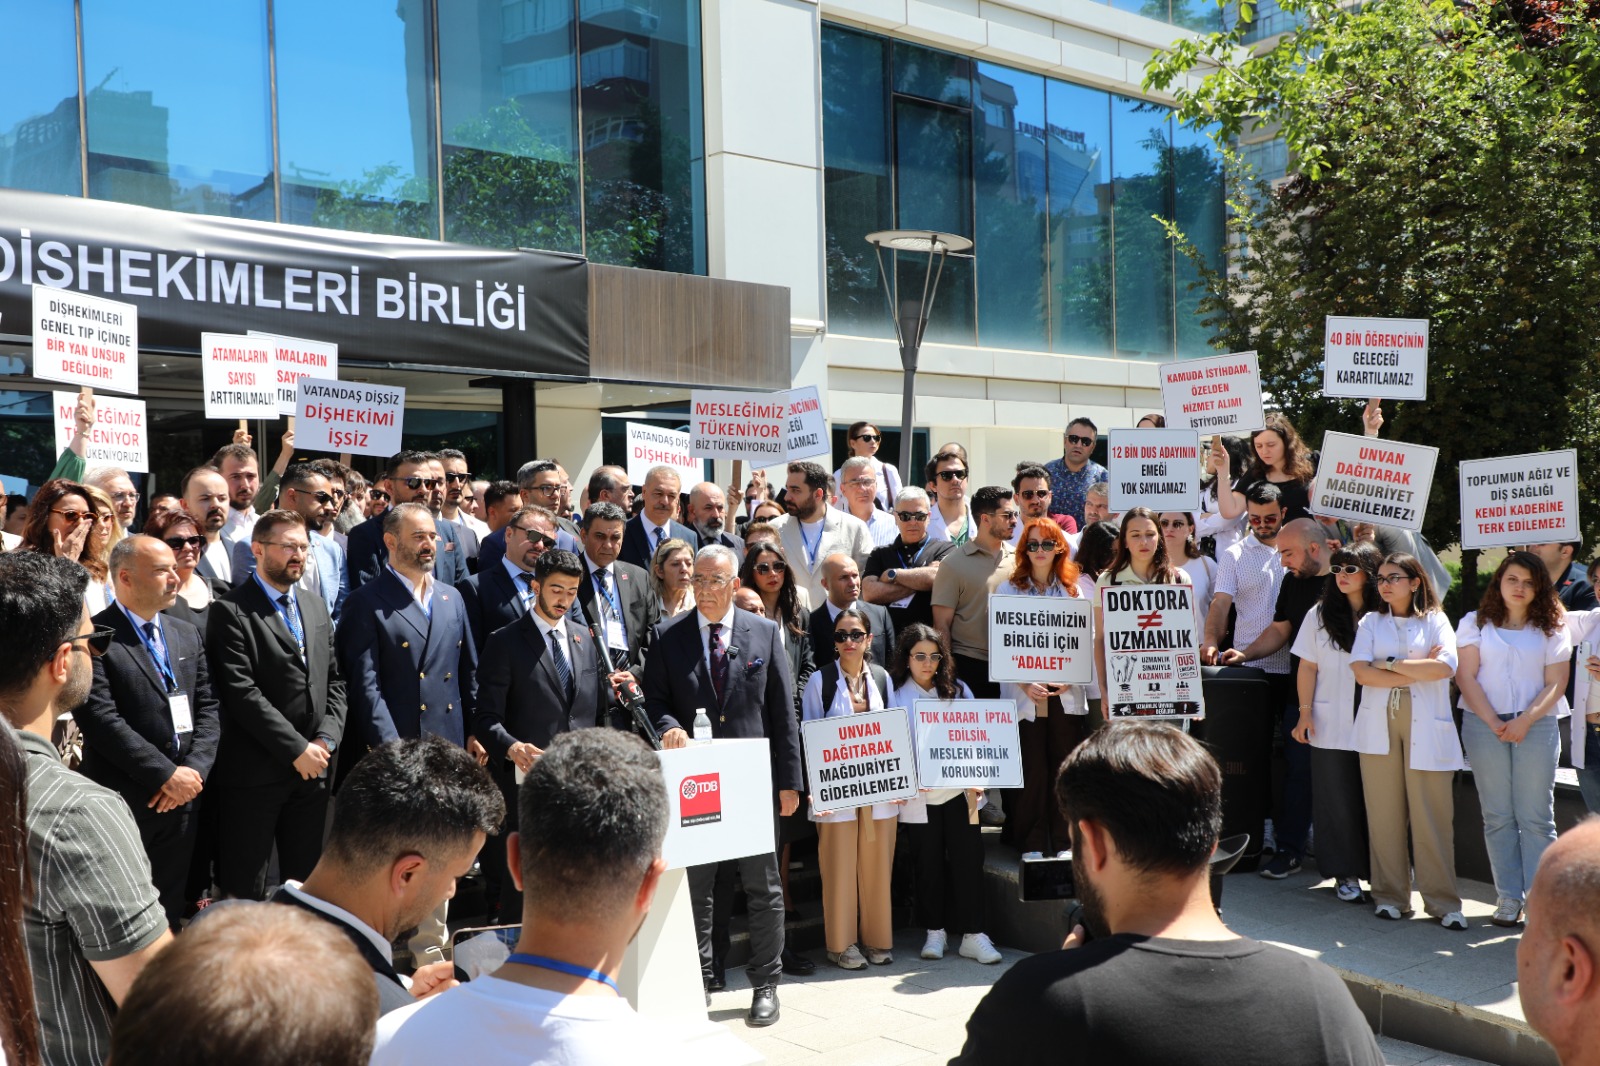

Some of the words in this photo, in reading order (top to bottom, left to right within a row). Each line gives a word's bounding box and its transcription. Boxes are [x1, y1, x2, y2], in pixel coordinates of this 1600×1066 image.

[376, 271, 526, 331] BİRLİĞİ
[50, 299, 123, 326] DİŞHEKİMLERİ
[41, 318, 75, 336] GENEL
[78, 326, 94, 339] TIP
[98, 327, 131, 347] İÇİNDE
[1330, 332, 1343, 345] 40
[1345, 330, 1362, 346] BİN
[1365, 330, 1424, 348] ÖĞRENCİNİN
[47, 337, 65, 353] BİR
[69, 342, 88, 357] YAN
[92, 346, 126, 364] UNSUR
[212, 347, 268, 363] ATAMALARIN
[1353, 350, 1399, 366] GELECEĞİ
[62, 359, 113, 379] DEĞİLDİR!
[228, 371, 256, 386] SAYISI
[1167, 369, 1204, 384] KAMUDA
[1205, 363, 1251, 379] İSTİHDAM,
[1337, 370, 1414, 386] KARARTILAMAZ!
[210, 390, 275, 406] ARTTIRILMALI!
[303, 384, 362, 403] VATANDAŞ
[365, 389, 400, 406] DİŞSİZ
[1191, 383, 1230, 396] ÖZELDEN
[305, 402, 395, 426] DİŞHEKİMİ
[695, 401, 784, 419] MESLEĞİMİZ
[1183, 399, 1215, 413] HİZMET
[1217, 397, 1242, 410] ALIMI
[698, 419, 780, 438] TÜKENİYOR
[1190, 414, 1238, 428] İSTİYORUZ!
[328, 427, 369, 448] İŞSİZ
[631, 429, 674, 447] VATANDAŞ
[695, 437, 710, 450] BİZ
[713, 438, 781, 453] TÜKENİYORUZ!
[1112, 446, 1122, 459] 12
[1124, 443, 1139, 458] BİN
[1141, 446, 1157, 458] DUS
[1159, 446, 1196, 458] ADAYININ
[1359, 447, 1405, 466] UNVAN
[1141, 461, 1167, 476] EMEĞİ
[1335, 461, 1411, 485] DAĞITARAK
[1467, 471, 1524, 487] TOPLUMUN
[1528, 467, 1553, 481] AĞIZ
[1556, 466, 1570, 478] VE
[1121, 482, 1137, 494] YOK
[1139, 482, 1187, 494] SAYILAMAZ!
[1326, 478, 1414, 503] MAĞDURİYET
[1491, 487, 1508, 502] DİŞ
[1511, 483, 1554, 499] SAĞLIĞI
[1320, 493, 1415, 521] GİDERİLEMEZ!
[1475, 503, 1507, 519] KENDİ
[1510, 500, 1563, 515] KADERİNE
[1478, 522, 1505, 534] TERK
[1508, 517, 1565, 532] EDİLEMEZ!
[1107, 589, 1189, 611] DOKTORA
[995, 610, 1087, 628] MESLEĞİMİZİN
[1003, 631, 1050, 649] BİRLİĞİ
[1053, 633, 1079, 653] İÇİN
[1109, 629, 1193, 650] UZMANLIK
[1177, 655, 1194, 666] DUS
[920, 711, 940, 724] TUK
[943, 711, 979, 724] KARARI
[985, 709, 1013, 724] İPTAL
[838, 721, 882, 741] UNVAN
[948, 727, 991, 744] EDİLSİN,
[822, 739, 894, 763] DAĞITARAK
[930, 745, 973, 760] MESLEKİ
[976, 745, 1010, 760] BİRLİK
[819, 757, 901, 783] MAĞDURİYET
[941, 765, 1000, 778] KORUNSUN!
[697, 780, 718, 793] TDB
[820, 775, 910, 802] GİDERİLEMEZ!
